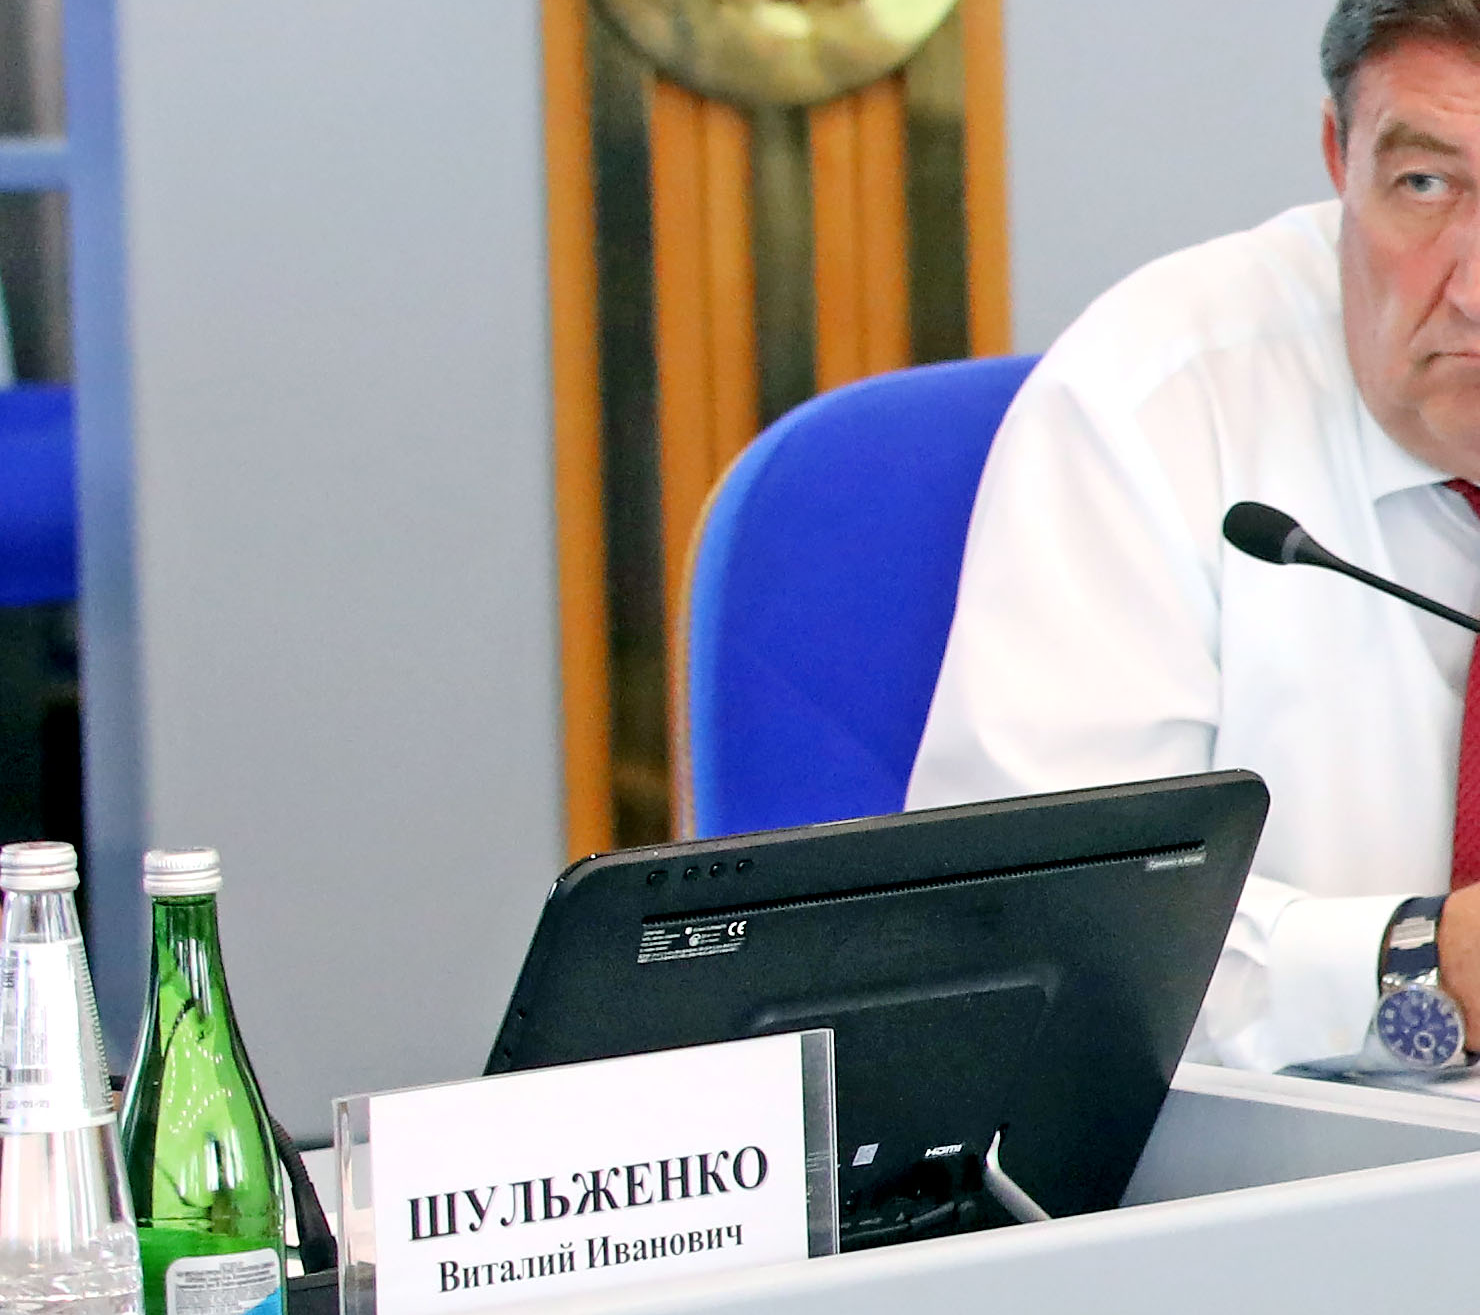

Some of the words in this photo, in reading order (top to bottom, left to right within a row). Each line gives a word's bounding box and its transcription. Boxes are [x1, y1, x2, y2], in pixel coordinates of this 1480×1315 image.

[727, 920, 747, 937] CE
[407, 1145, 769, 1242] ШУЛЬЖЕНКО
[437, 1242, 576, 1293] Виталий
[586, 1224, 744, 1269] Иванович
